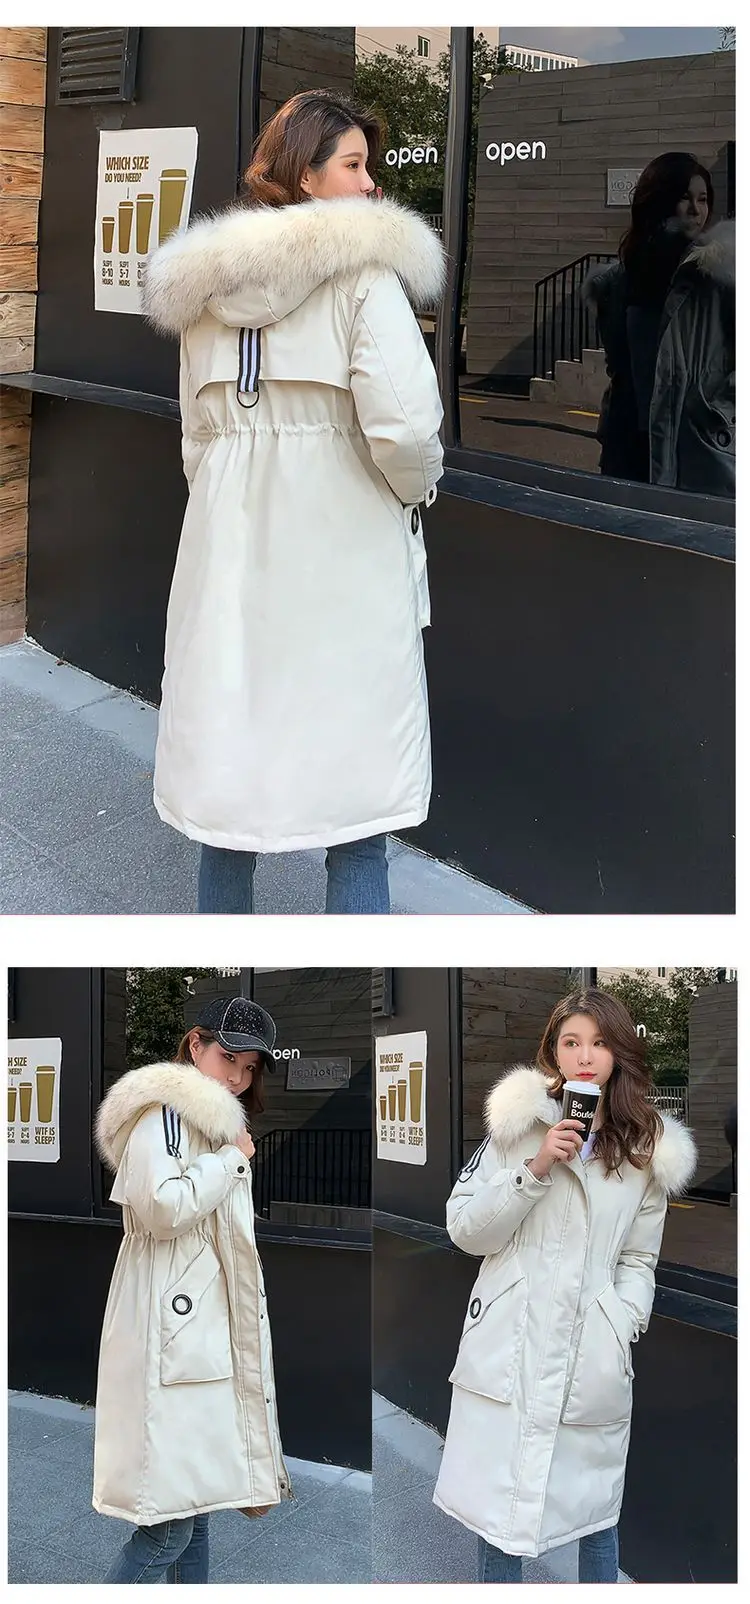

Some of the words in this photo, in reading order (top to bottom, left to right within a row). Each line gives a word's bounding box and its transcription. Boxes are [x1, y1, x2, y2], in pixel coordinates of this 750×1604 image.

[385, 146, 438, 168] open
[486, 141, 546, 166] open
[106, 157, 131, 170] WHICH
[132, 156, 149, 170] SIZE
[105, 173, 113, 182] DO
[113, 173, 124, 182] YOU
[125, 172, 142, 182] NEED?
[102, 268, 113, 277] 8-10
[120, 269, 129, 278] 5-7
[272, 1048, 300, 1060] pen
[14, 1057, 27, 1066] SIZE
[572, 1100, 583, 1109] Be
[35, 1127, 48, 1136] WTF
[49, 1127, 55, 1136] IS
[35, 1136, 55, 1145] SLEEP?
